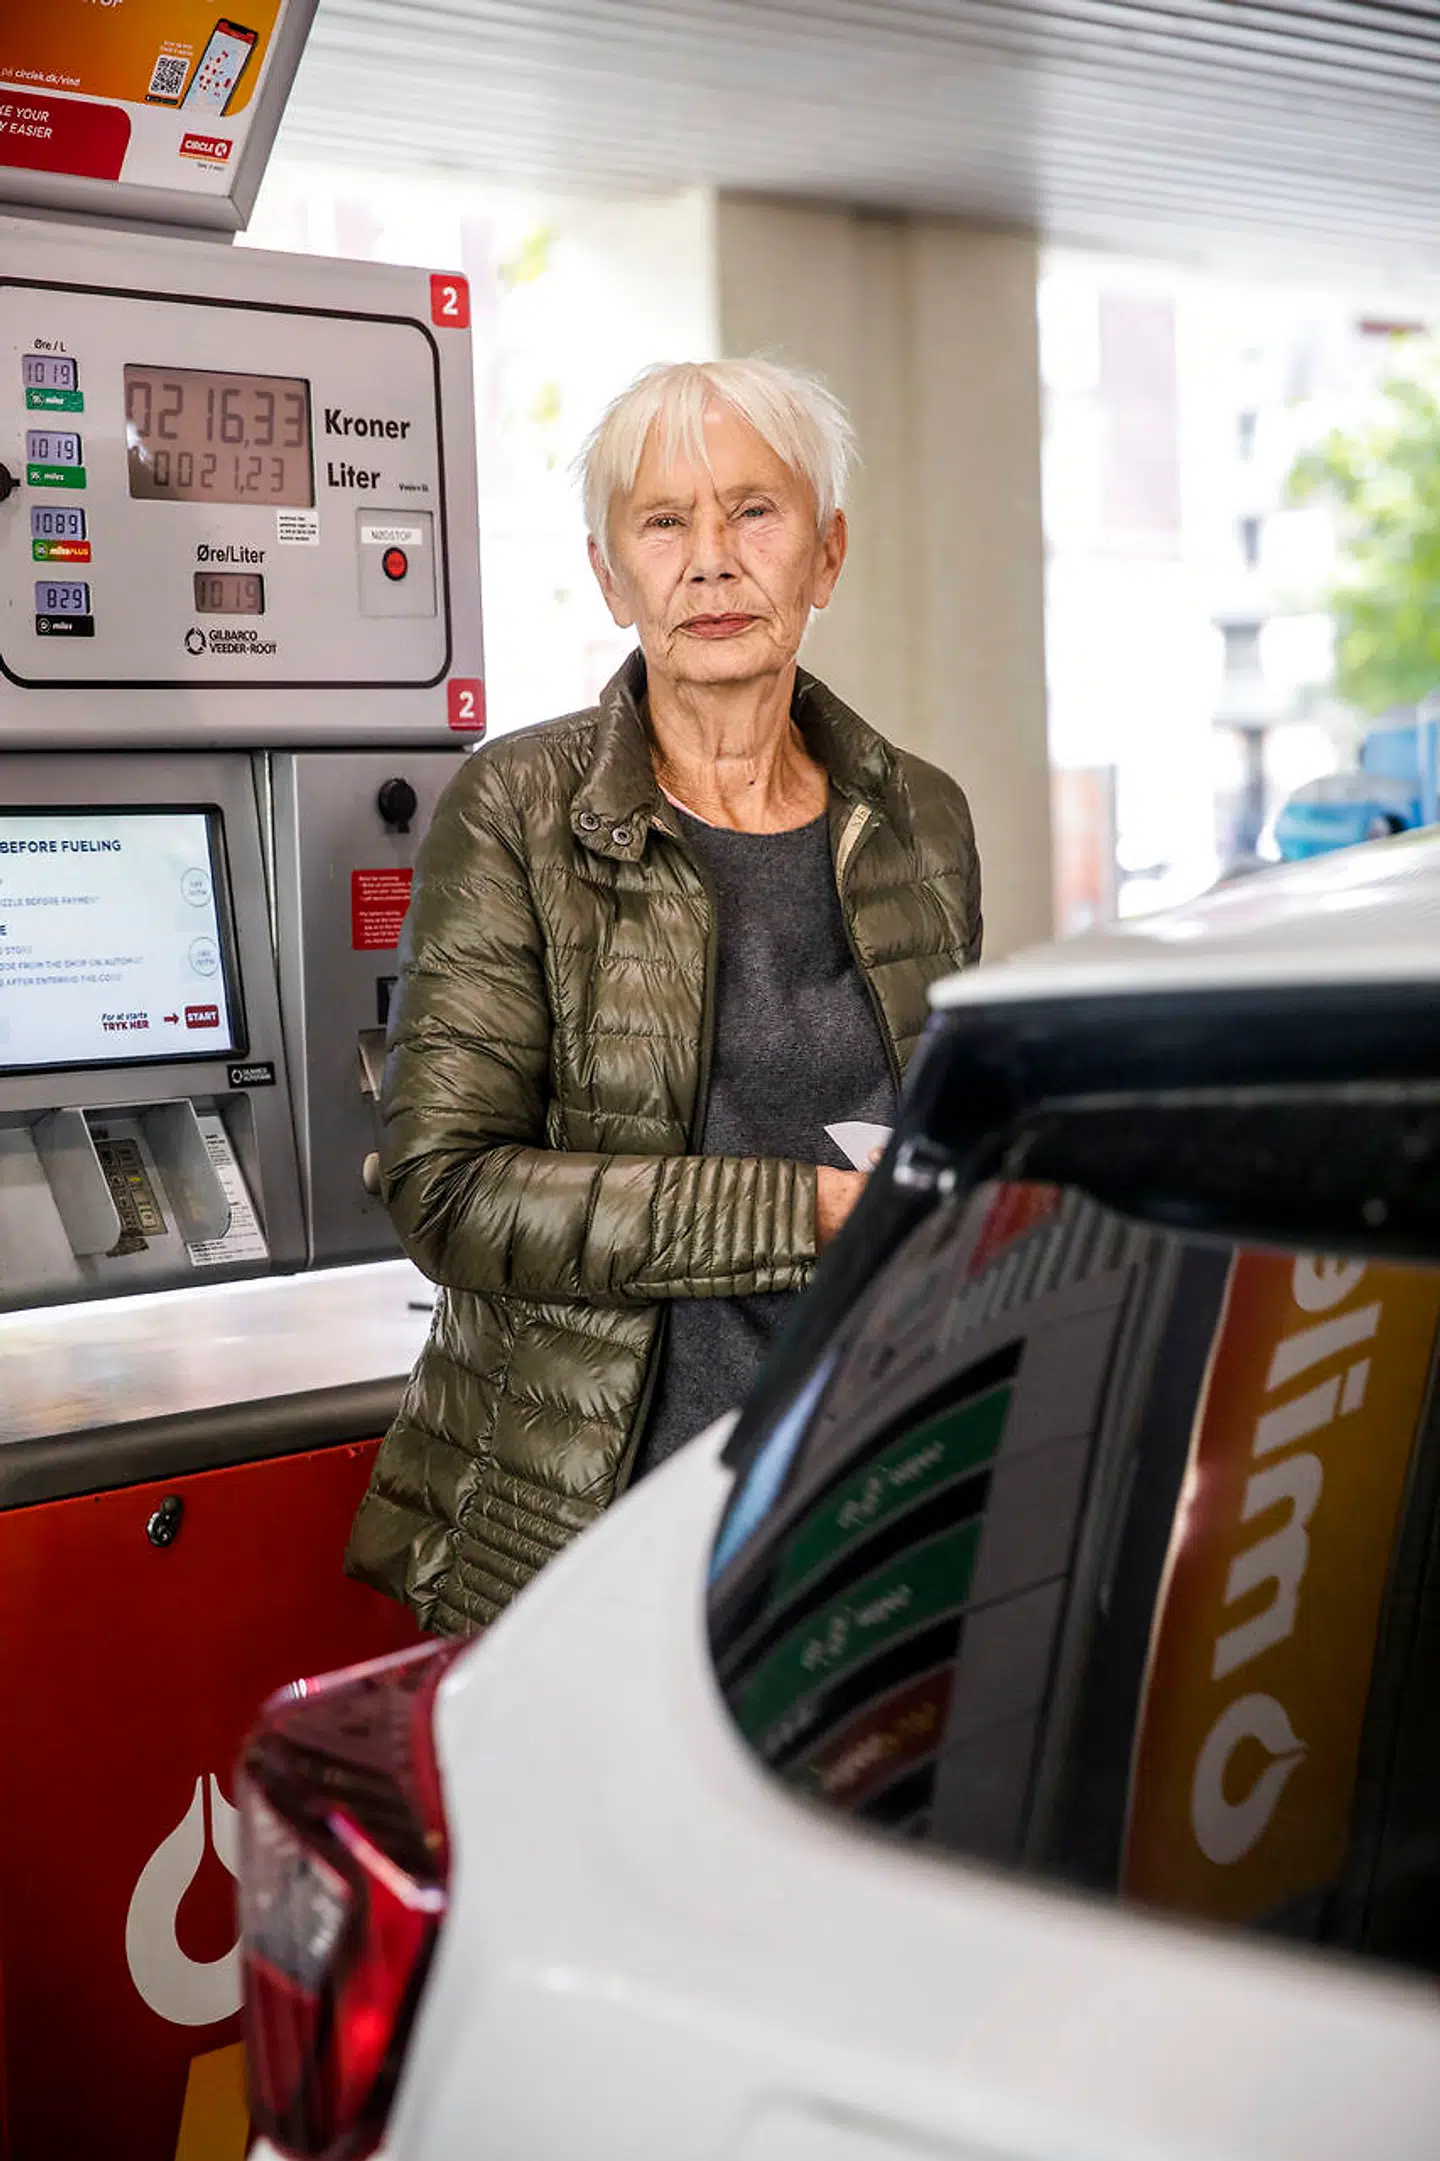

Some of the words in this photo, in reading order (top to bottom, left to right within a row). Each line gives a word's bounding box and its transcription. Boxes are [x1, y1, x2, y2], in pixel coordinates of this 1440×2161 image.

[16, 107, 50, 122] YOUR
[9, 122, 53, 139] EASIER
[442, 286, 459, 315] 2
[28, 362, 70, 385] 1019
[324, 408, 411, 439] Kroner
[31, 438, 74, 460] 1019
[327, 462, 381, 489] Liter
[35, 513, 78, 535] 1089
[197, 543, 266, 564] Øre/Liter
[47, 588, 83, 609] 829
[200, 580, 258, 609] 1019
[209, 629, 258, 641] GILBARCO
[209, 643, 277, 655] VEEDER-ROOT
[459, 690, 475, 719] 2
[0, 840, 57, 854] BEFORE
[61, 839, 122, 852] FUELING
[102, 1021, 128, 1032] TRYK
[130, 1020, 150, 1030] HER
[187, 1011, 217, 1022] START
